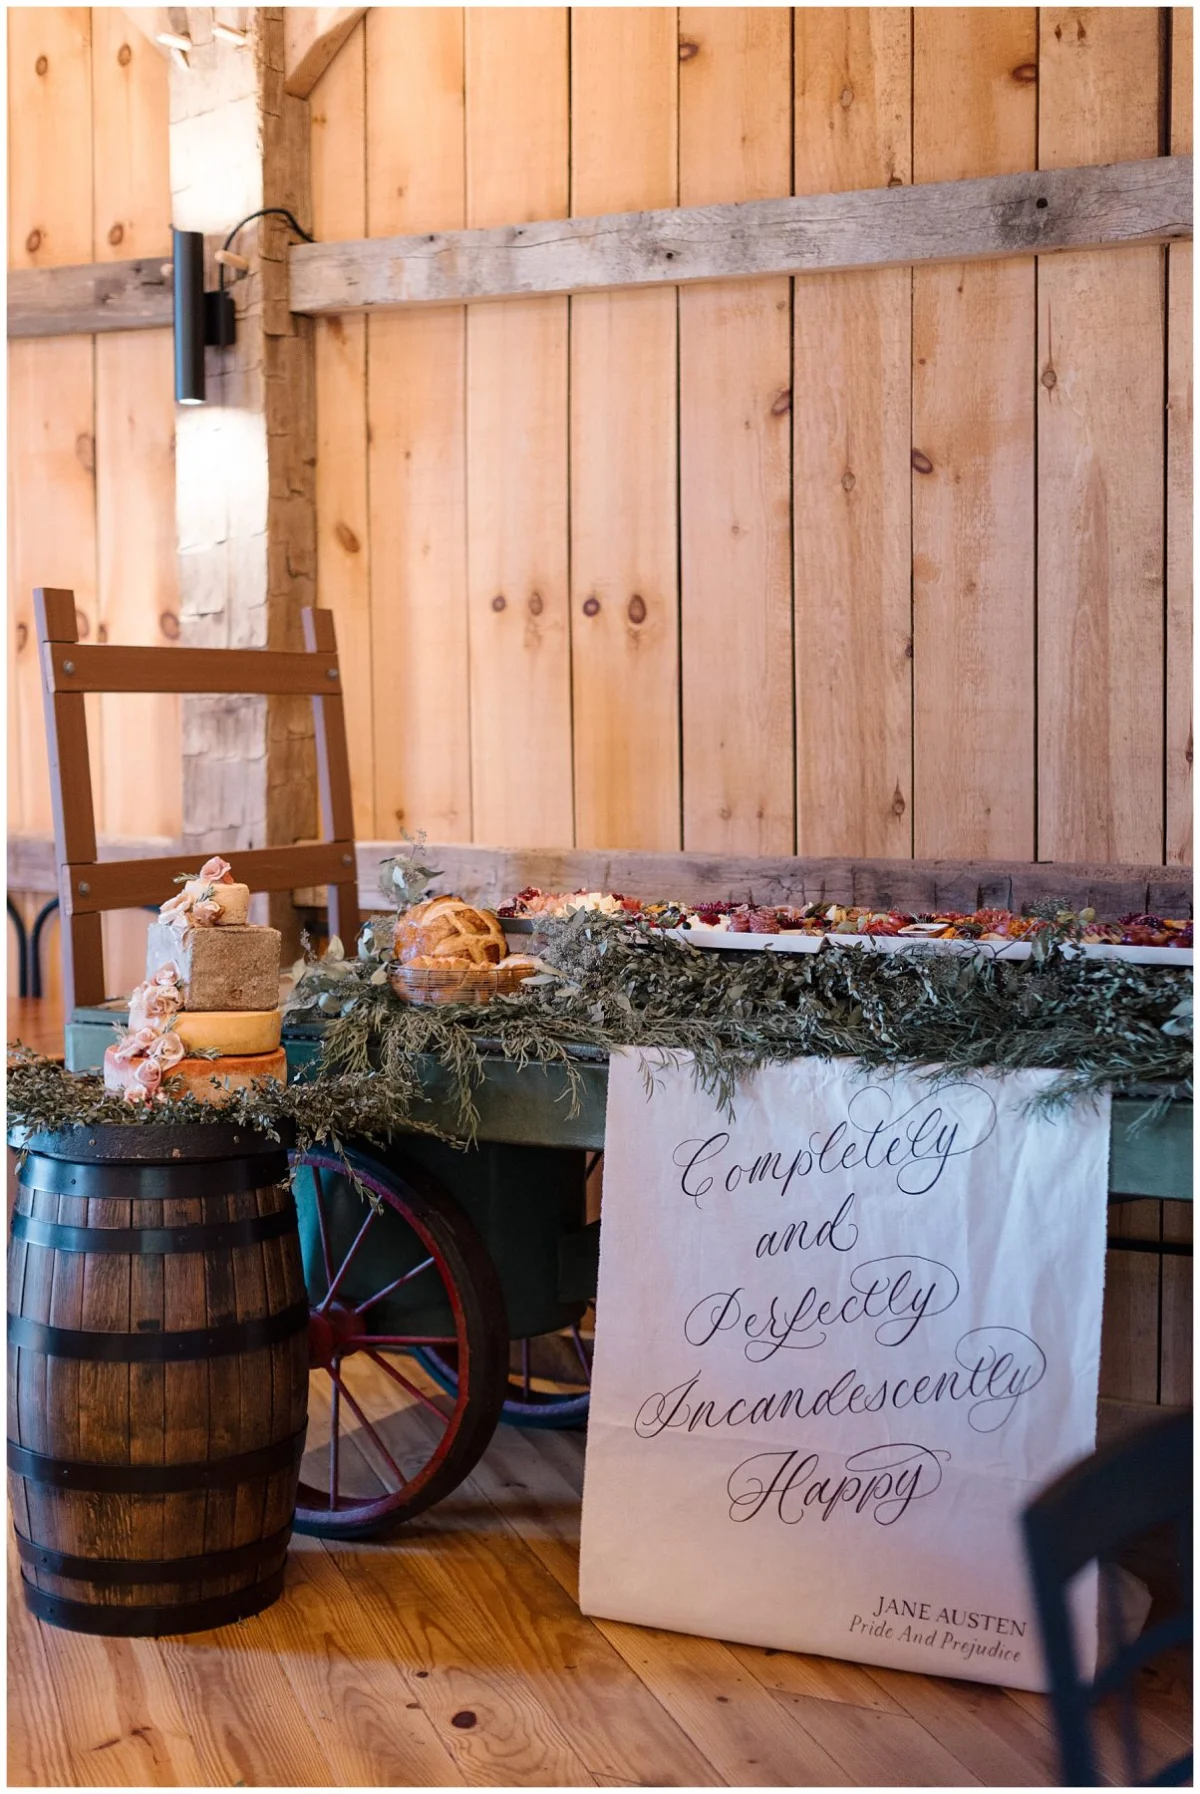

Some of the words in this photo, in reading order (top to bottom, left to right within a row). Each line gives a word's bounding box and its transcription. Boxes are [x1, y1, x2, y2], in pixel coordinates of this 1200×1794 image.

[673, 1083, 997, 1209] Completely
[756, 1193, 858, 1258] and
[684, 1256, 959, 1362] Perfectly
[634, 1326, 1046, 1438] Incandescently
[727, 1443, 951, 1525] Happy
[850, 1614, 893, 1639] Pride
[898, 1625, 938, 1647] And
[940, 1631, 1021, 1662] Prejudice
[873, 1596, 931, 1620] JANE
[936, 1608, 1026, 1637] AUSTEN
